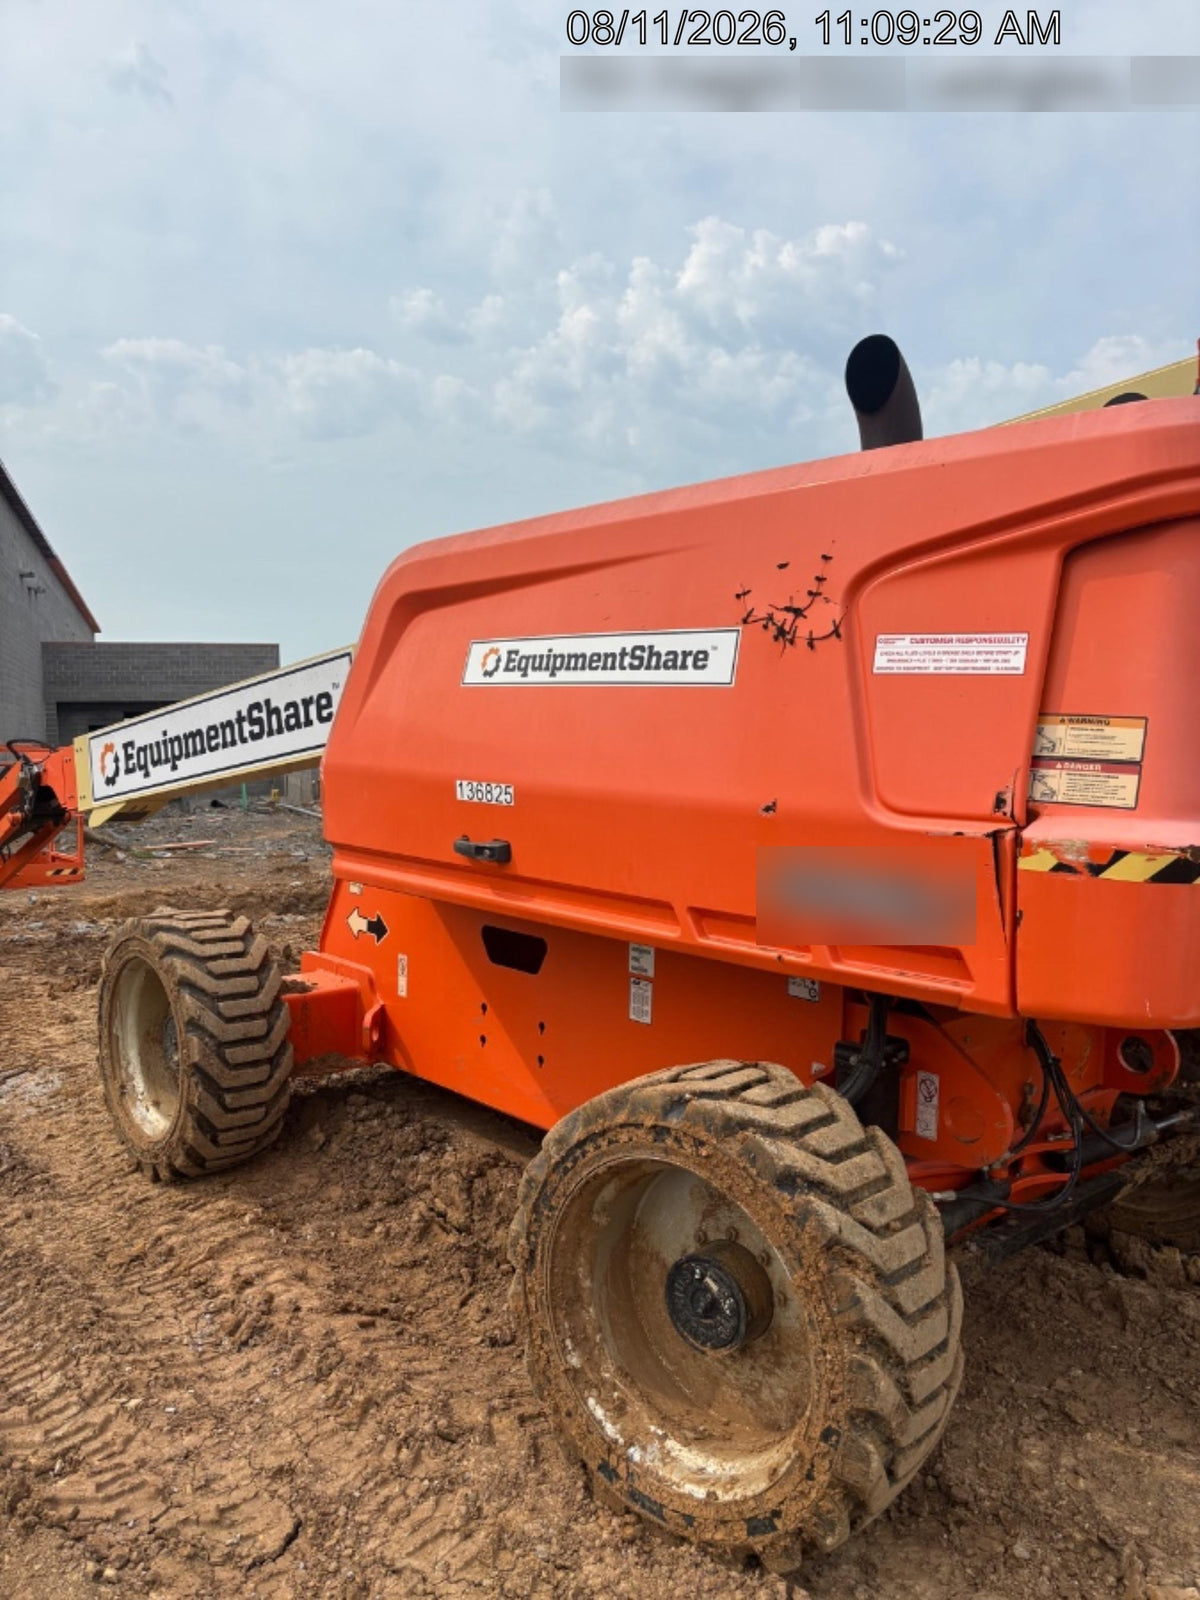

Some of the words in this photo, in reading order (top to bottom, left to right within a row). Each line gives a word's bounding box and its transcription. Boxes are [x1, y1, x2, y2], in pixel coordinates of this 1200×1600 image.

[502, 645, 709, 678] EquipmentShare
[1068, 717, 1111, 726] WARNING
[122, 691, 334, 778] EquipmentShare
[1063, 762, 1102, 771] DANGER
[457, 781, 513, 804] 136825
